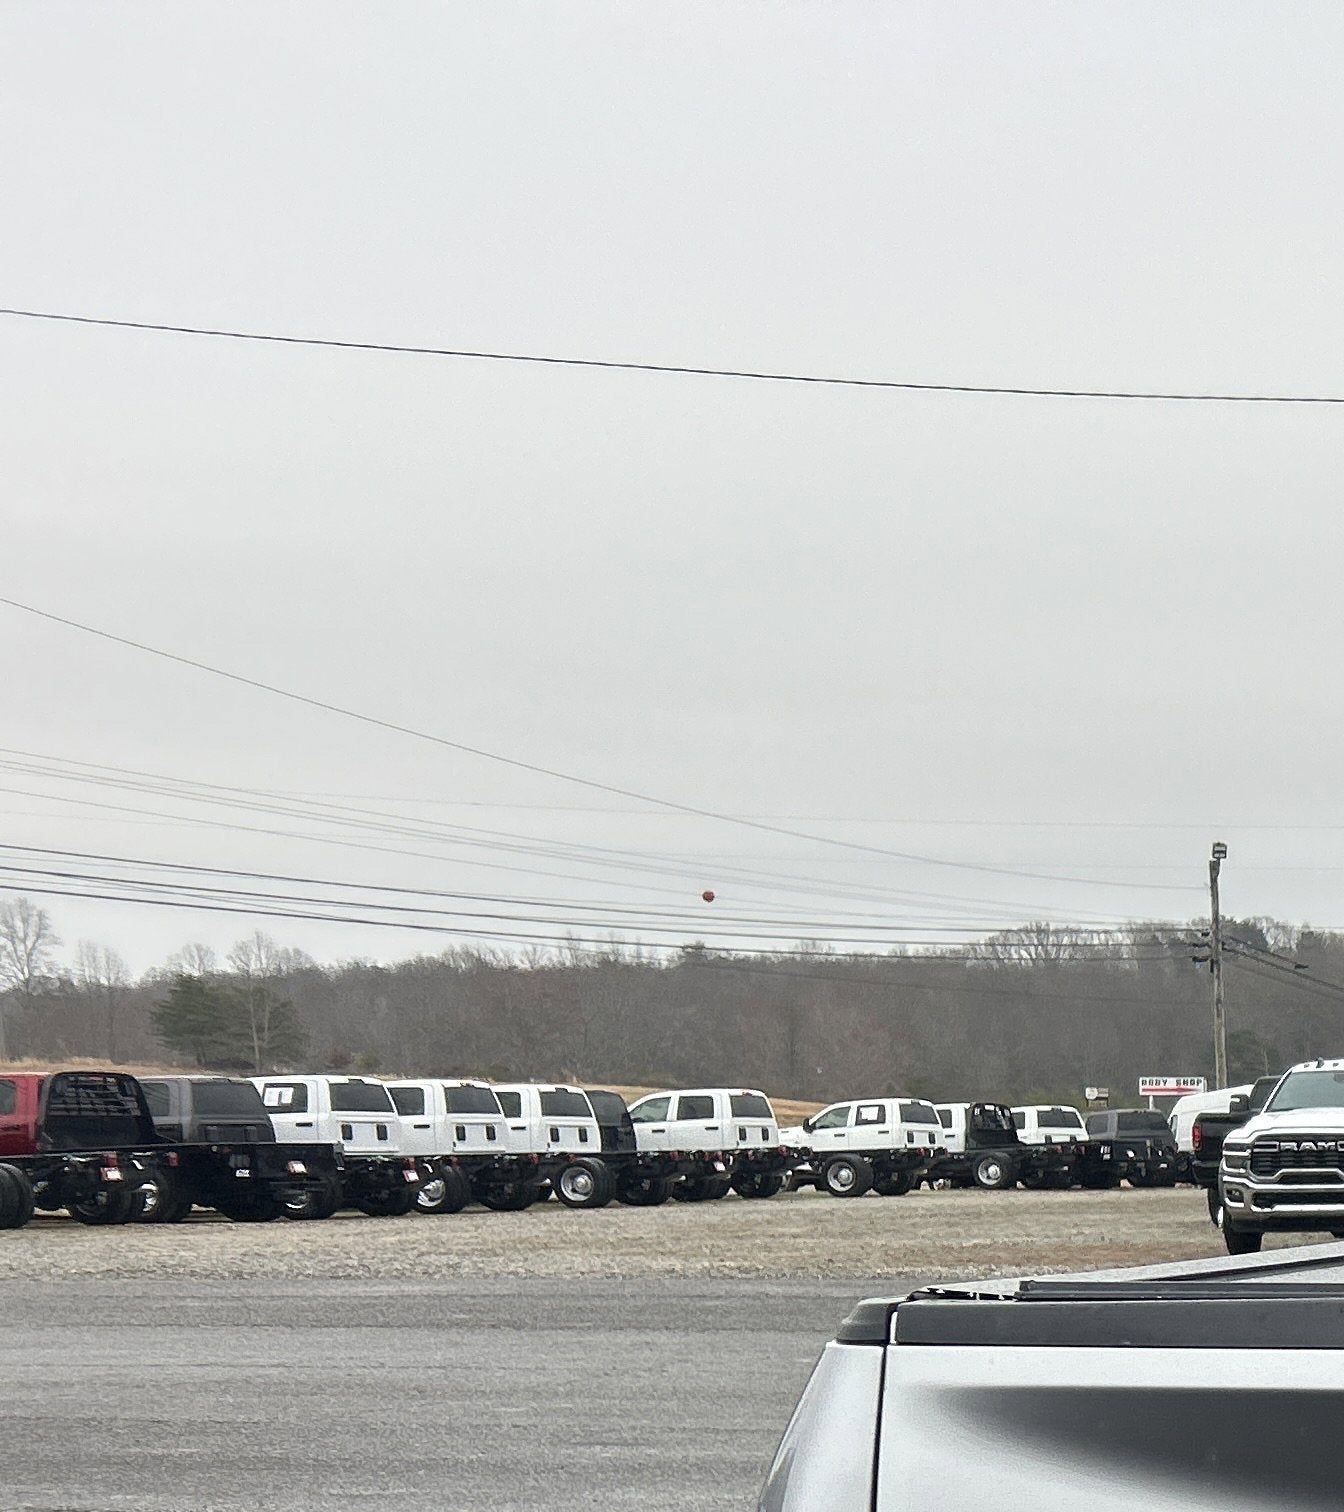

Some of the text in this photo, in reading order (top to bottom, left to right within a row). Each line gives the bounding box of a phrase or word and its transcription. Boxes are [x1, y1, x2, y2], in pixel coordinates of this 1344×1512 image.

[1141, 1079, 1203, 1087] BODY SHOP
[1280, 1141, 1336, 1151] RAM
